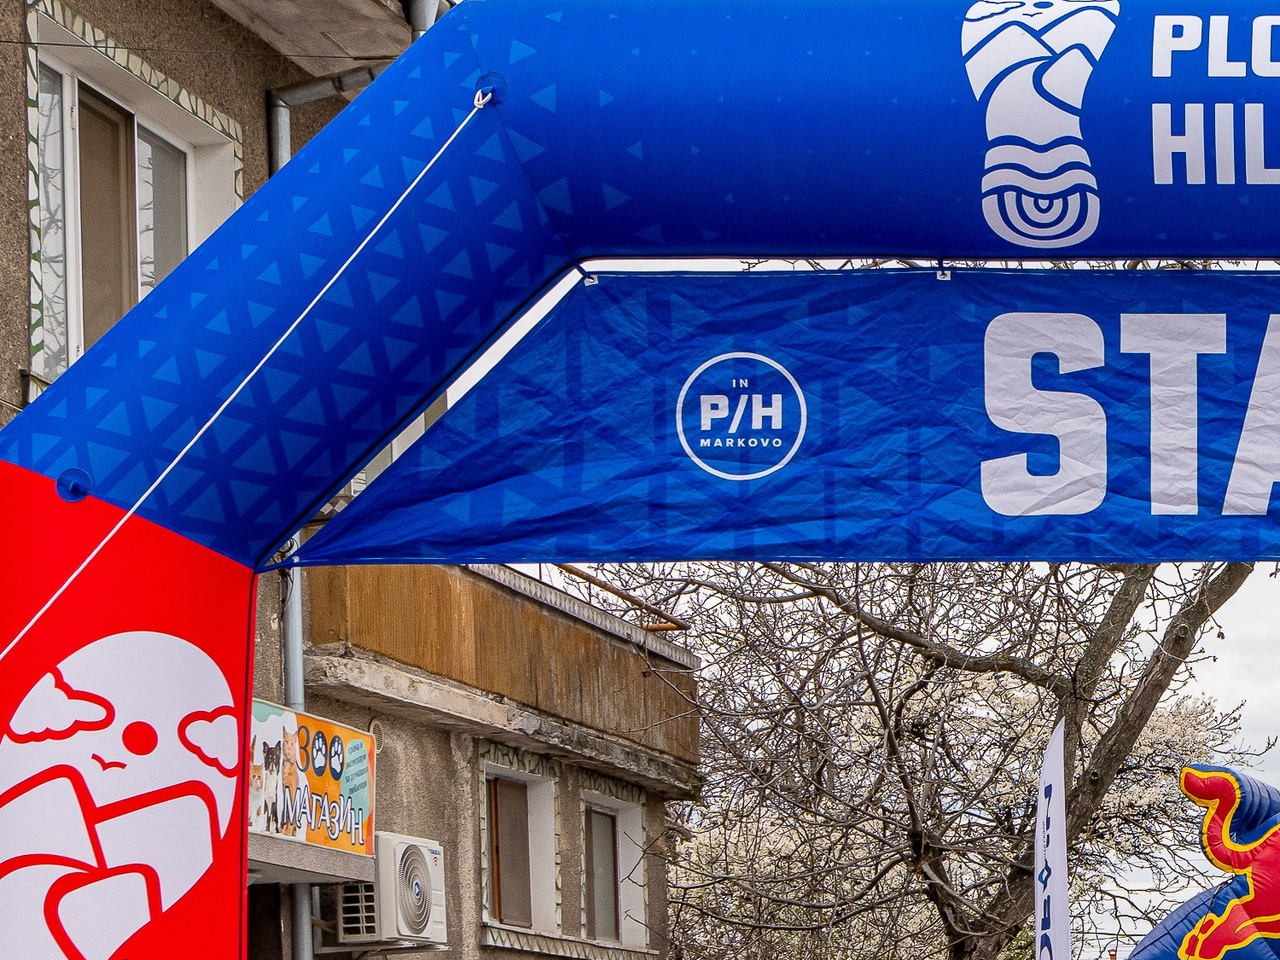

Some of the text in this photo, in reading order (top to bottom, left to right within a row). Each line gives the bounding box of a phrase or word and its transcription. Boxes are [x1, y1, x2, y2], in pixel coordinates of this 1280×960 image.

[731, 378, 749, 388] IN
[700, 393, 783, 434] P/H
[699, 438, 783, 448] MARKOVO
[282, 785, 364, 845] МАГАЗИН
